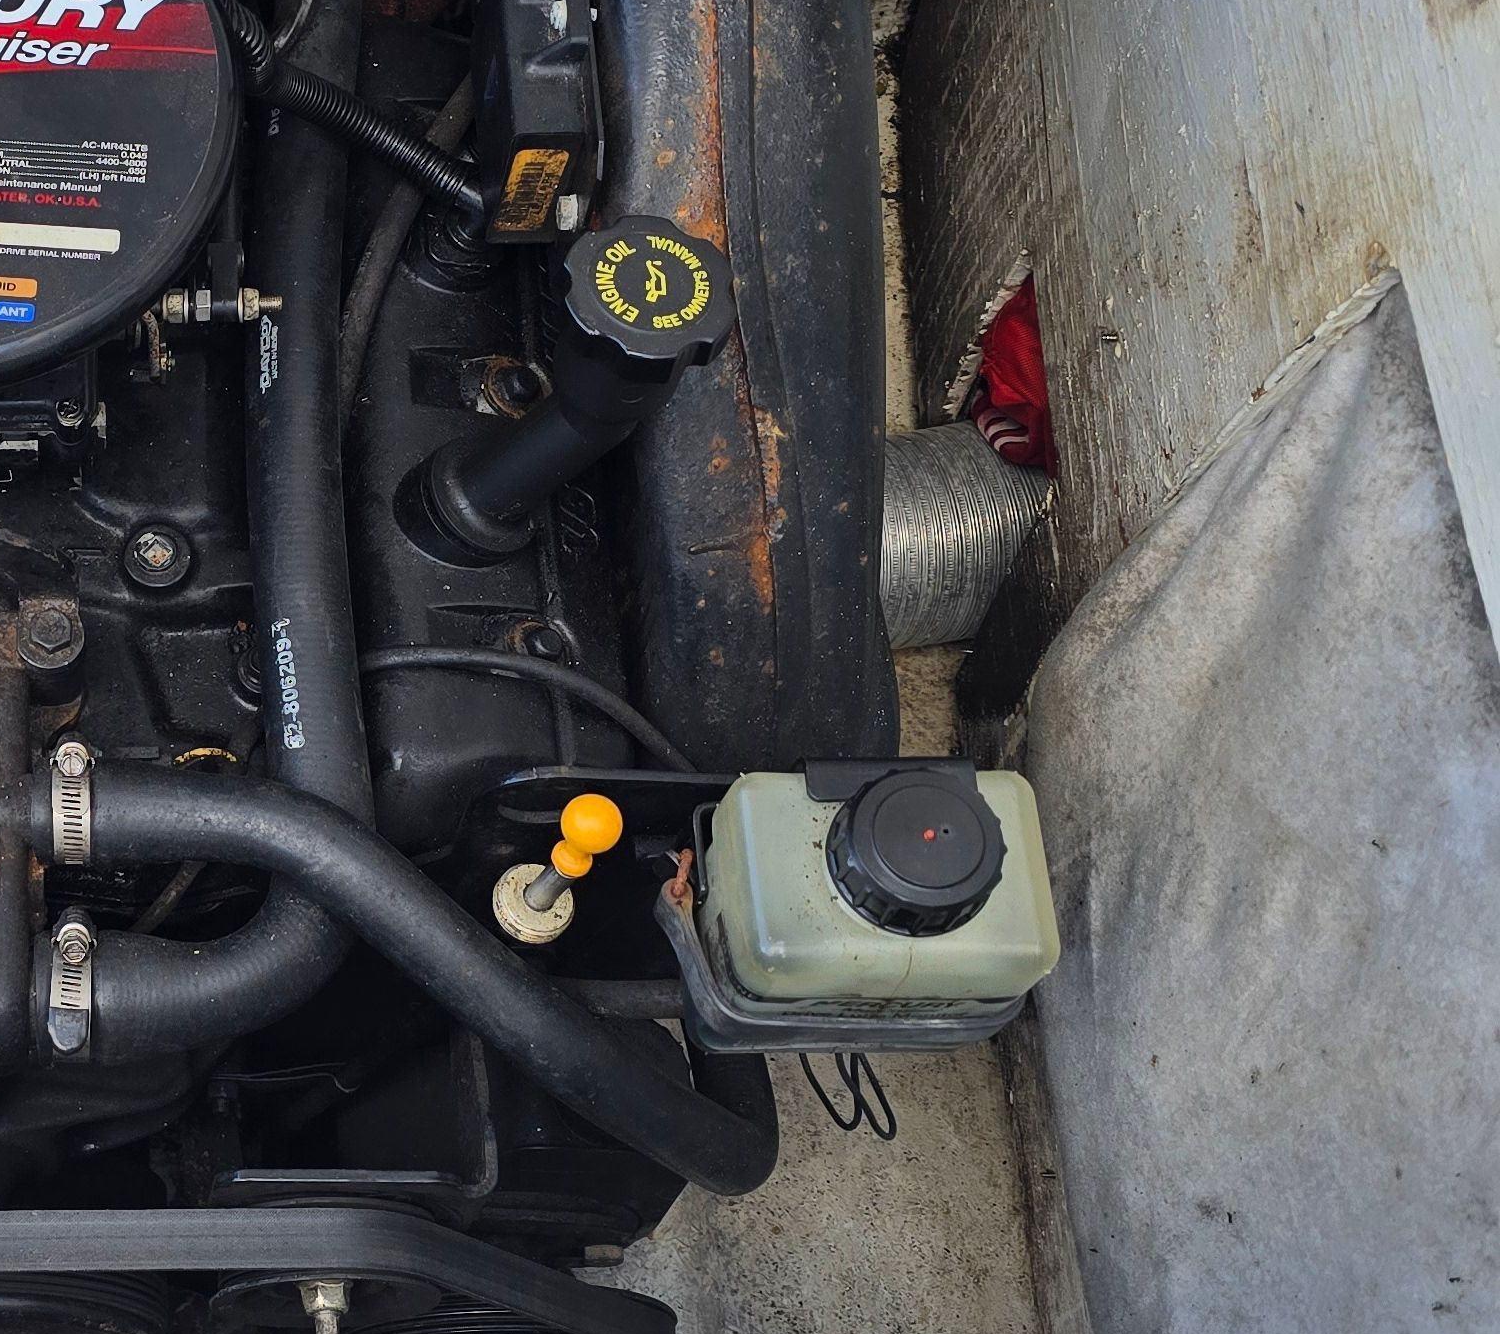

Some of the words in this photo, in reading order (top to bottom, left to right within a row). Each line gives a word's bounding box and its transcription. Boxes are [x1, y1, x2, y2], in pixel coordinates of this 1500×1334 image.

[79, 171, 99, 181] (LH)
[102, 173, 117, 181] left
[120, 174, 145, 183] hand
[60, 182, 101, 192] Manual
[63, 196, 101, 207] U.S.A.
[0, 248, 26, 256] DRIVE
[28, 249, 59, 257] SERIAL
[61, 252, 100, 260] NUMBER
[605, 240, 637, 262] OIL
[646, 236, 701, 269] MANUAL
[595, 260, 640, 323] ENGINE
[653, 313, 682, 329] SEE
